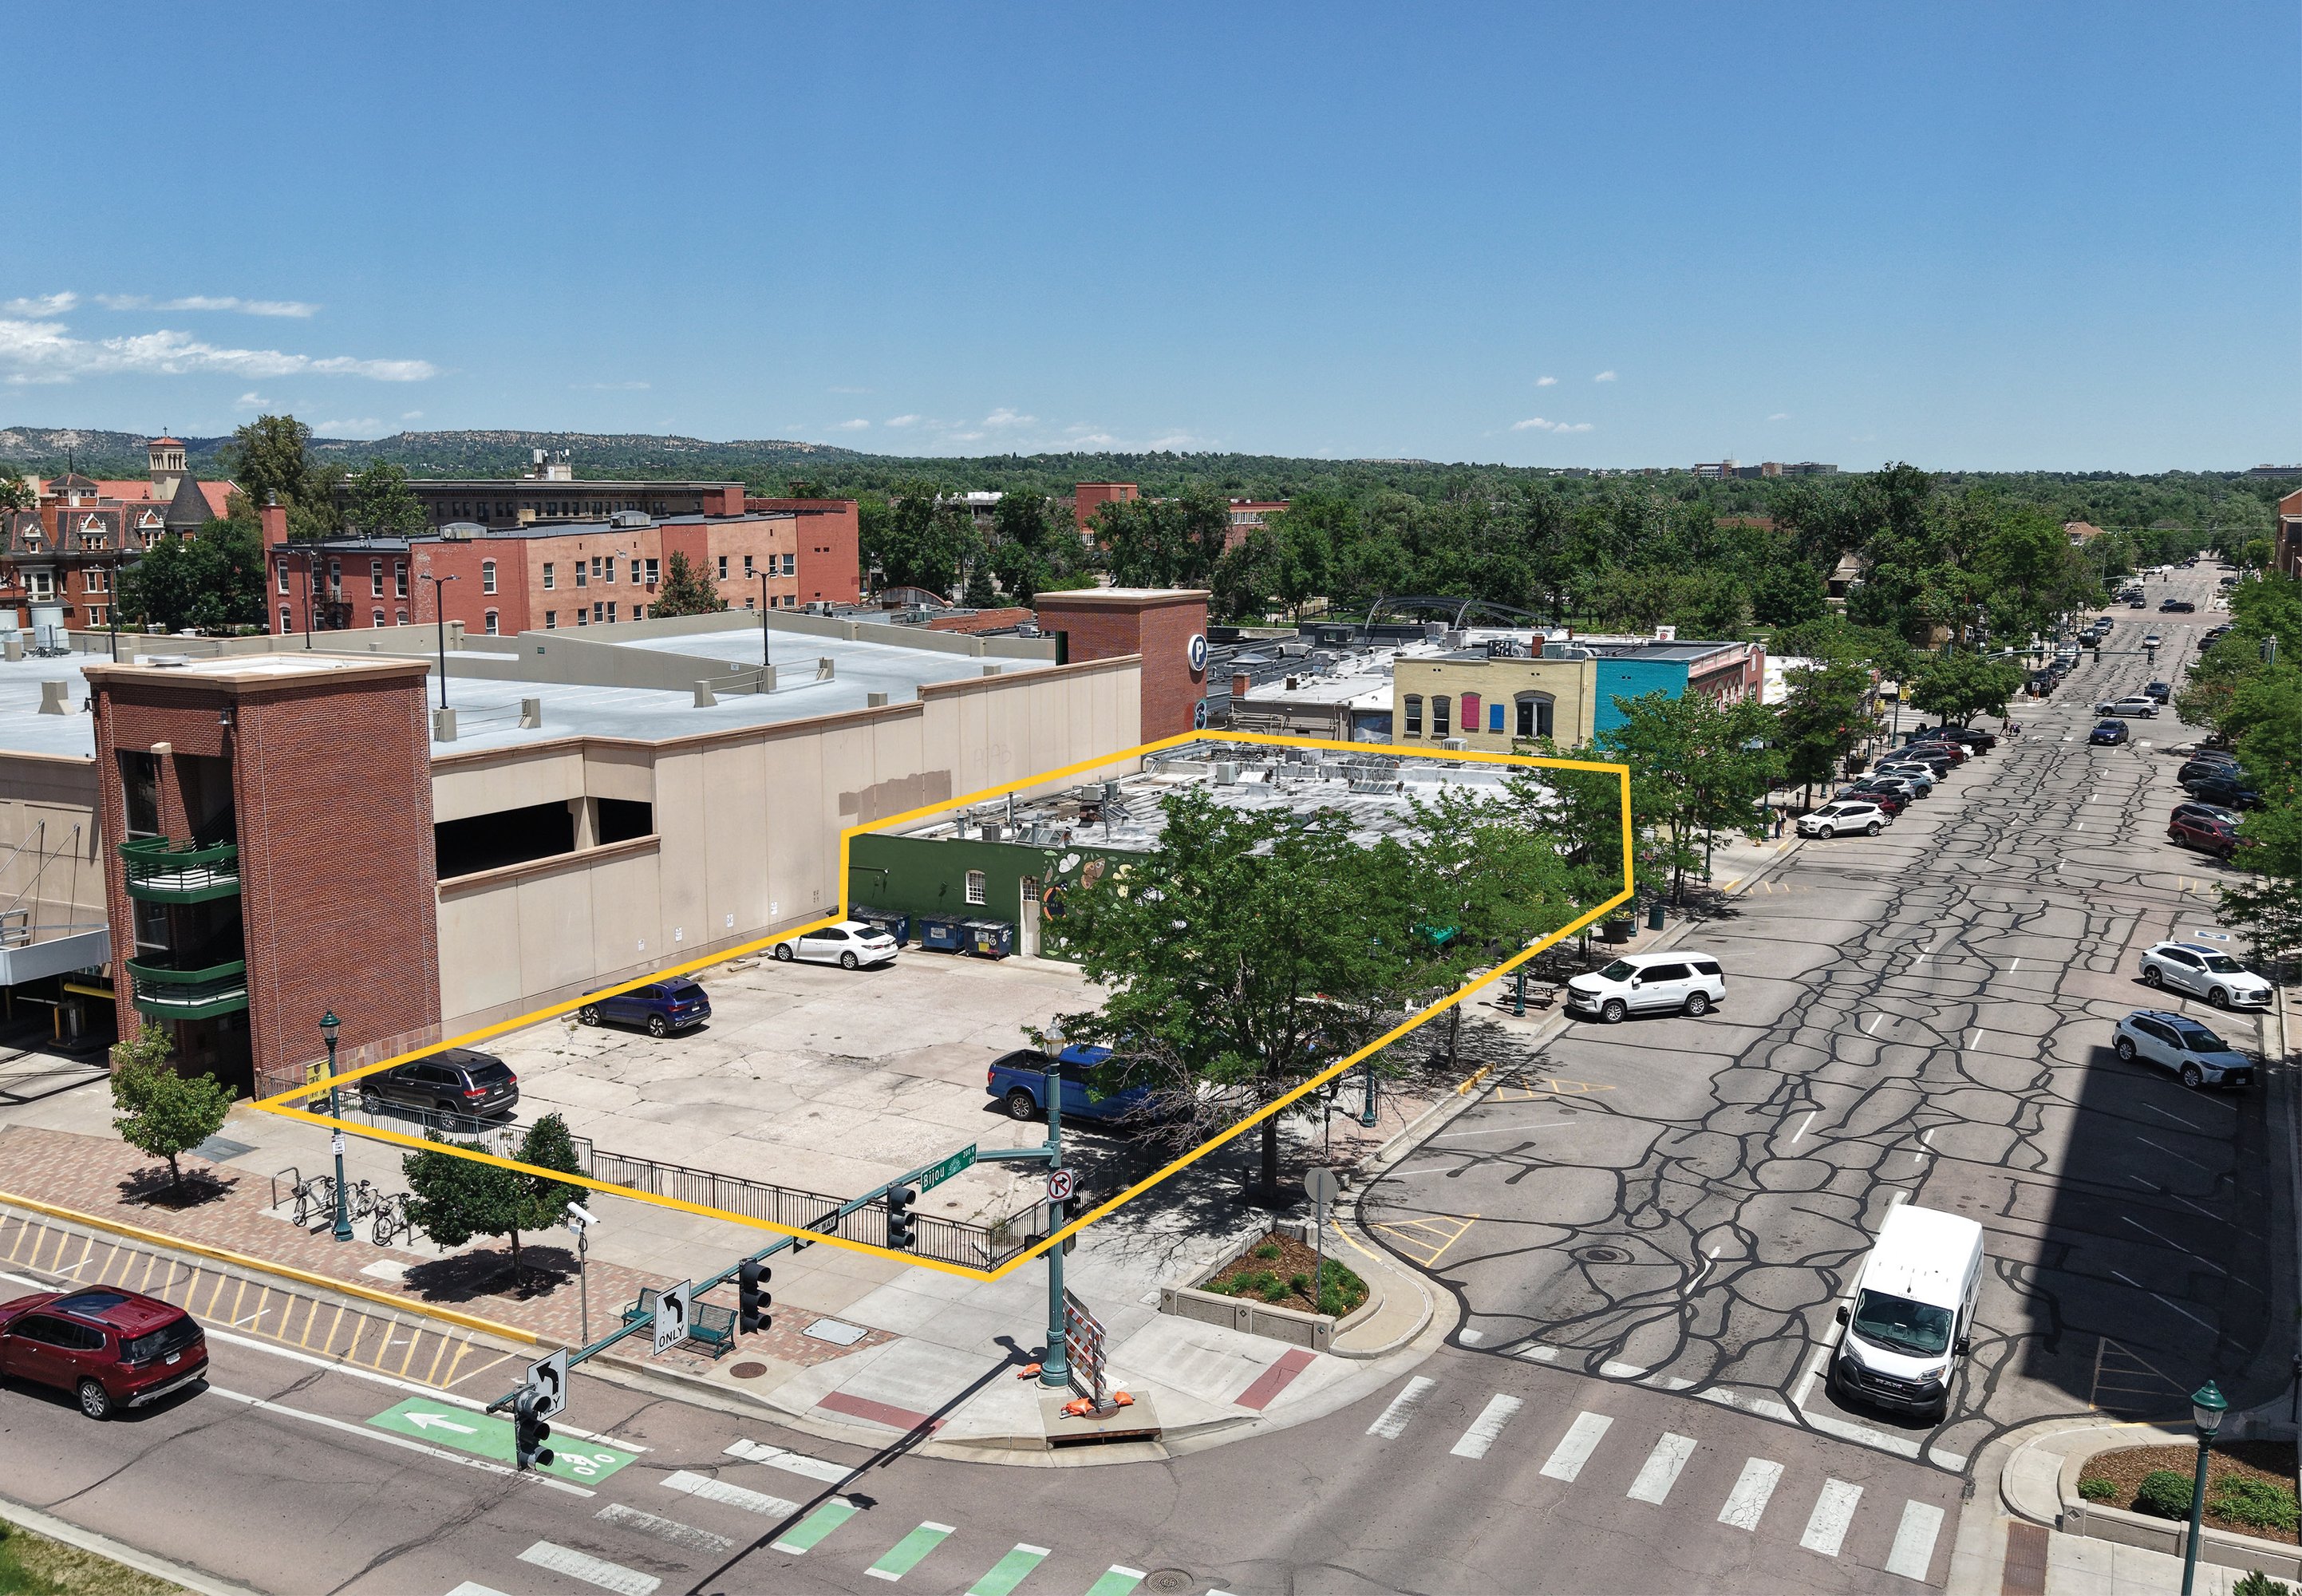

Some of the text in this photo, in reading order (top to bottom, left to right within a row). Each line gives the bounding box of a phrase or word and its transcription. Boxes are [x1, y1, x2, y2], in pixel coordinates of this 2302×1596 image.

[1195, 641, 1204, 662] P
[922, 1166, 945, 1187] Bijou
[659, 1324, 685, 1347] ONLY
